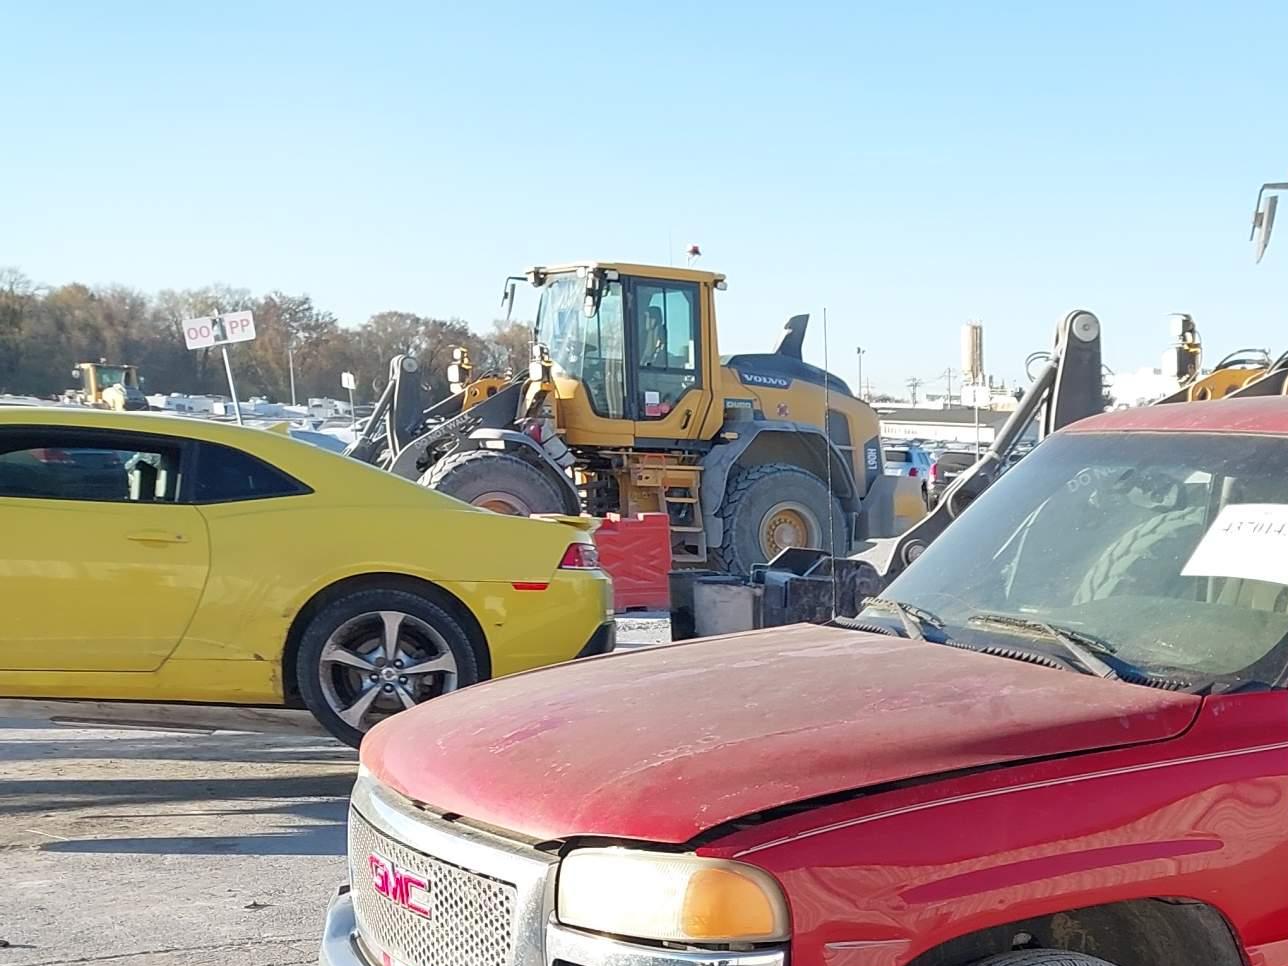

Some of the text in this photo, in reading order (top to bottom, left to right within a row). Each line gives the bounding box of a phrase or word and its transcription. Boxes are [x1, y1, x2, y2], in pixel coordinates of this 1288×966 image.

[229, 318, 250, 335] PP
[742, 373, 788, 386] VOLVO
[367, 851, 432, 920] GMC
